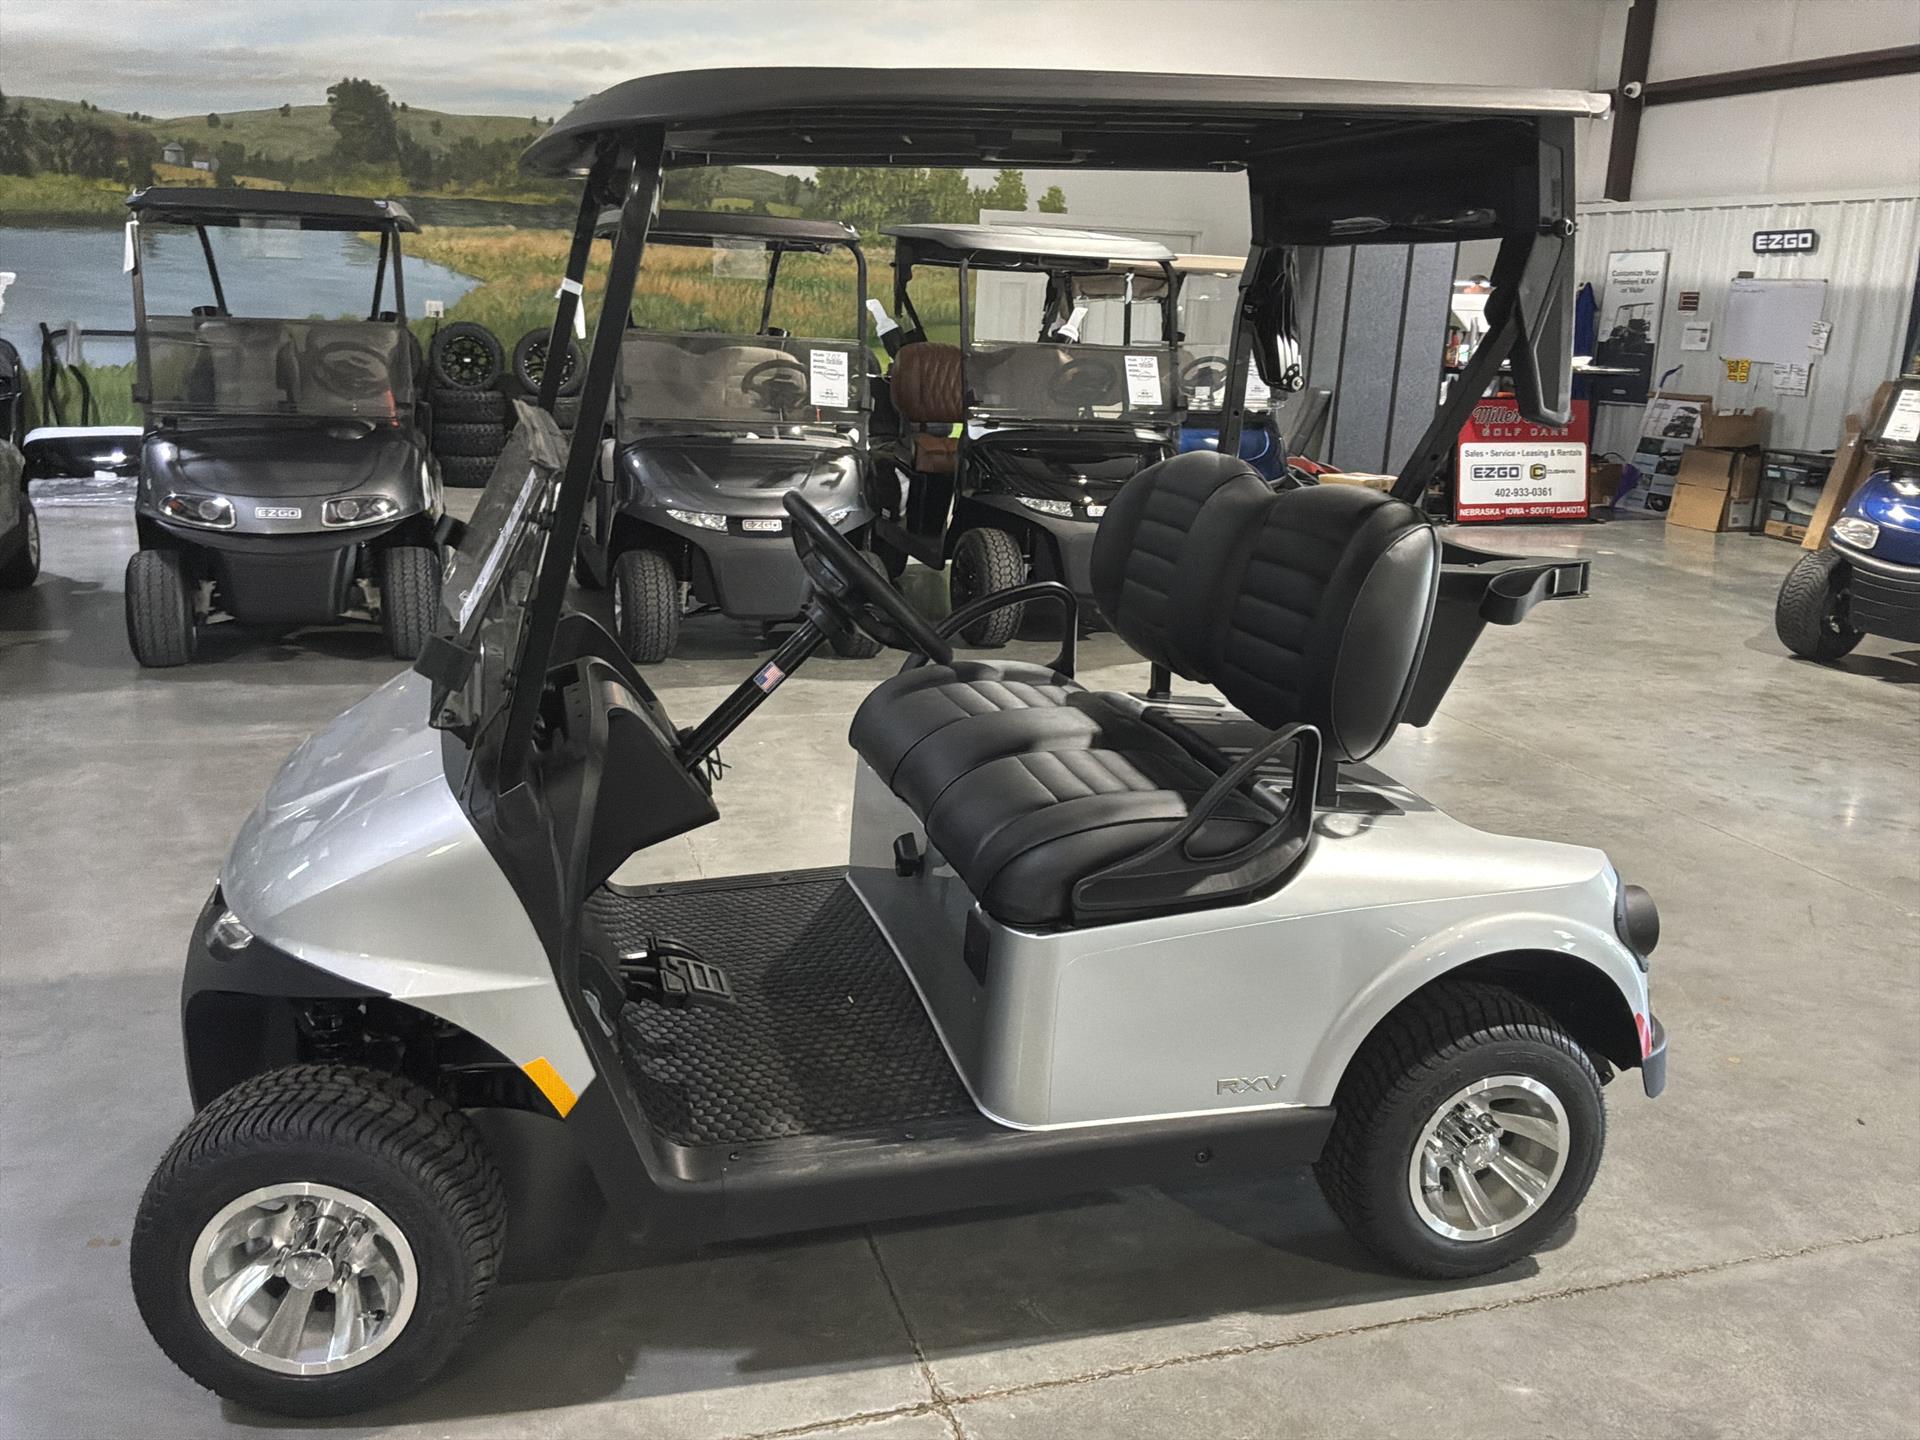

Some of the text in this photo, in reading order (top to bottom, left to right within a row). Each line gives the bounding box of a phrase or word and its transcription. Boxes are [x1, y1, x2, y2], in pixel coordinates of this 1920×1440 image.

[1465, 450, 1484, 458] Sales
[1490, 449, 1516, 457] Service
[1521, 449, 1548, 458] Leasing
[1495, 487, 1552, 497] 402-933-0361
[1529, 506, 1555, 514] SOUTH
[1217, 1075, 1287, 1095] RXV
